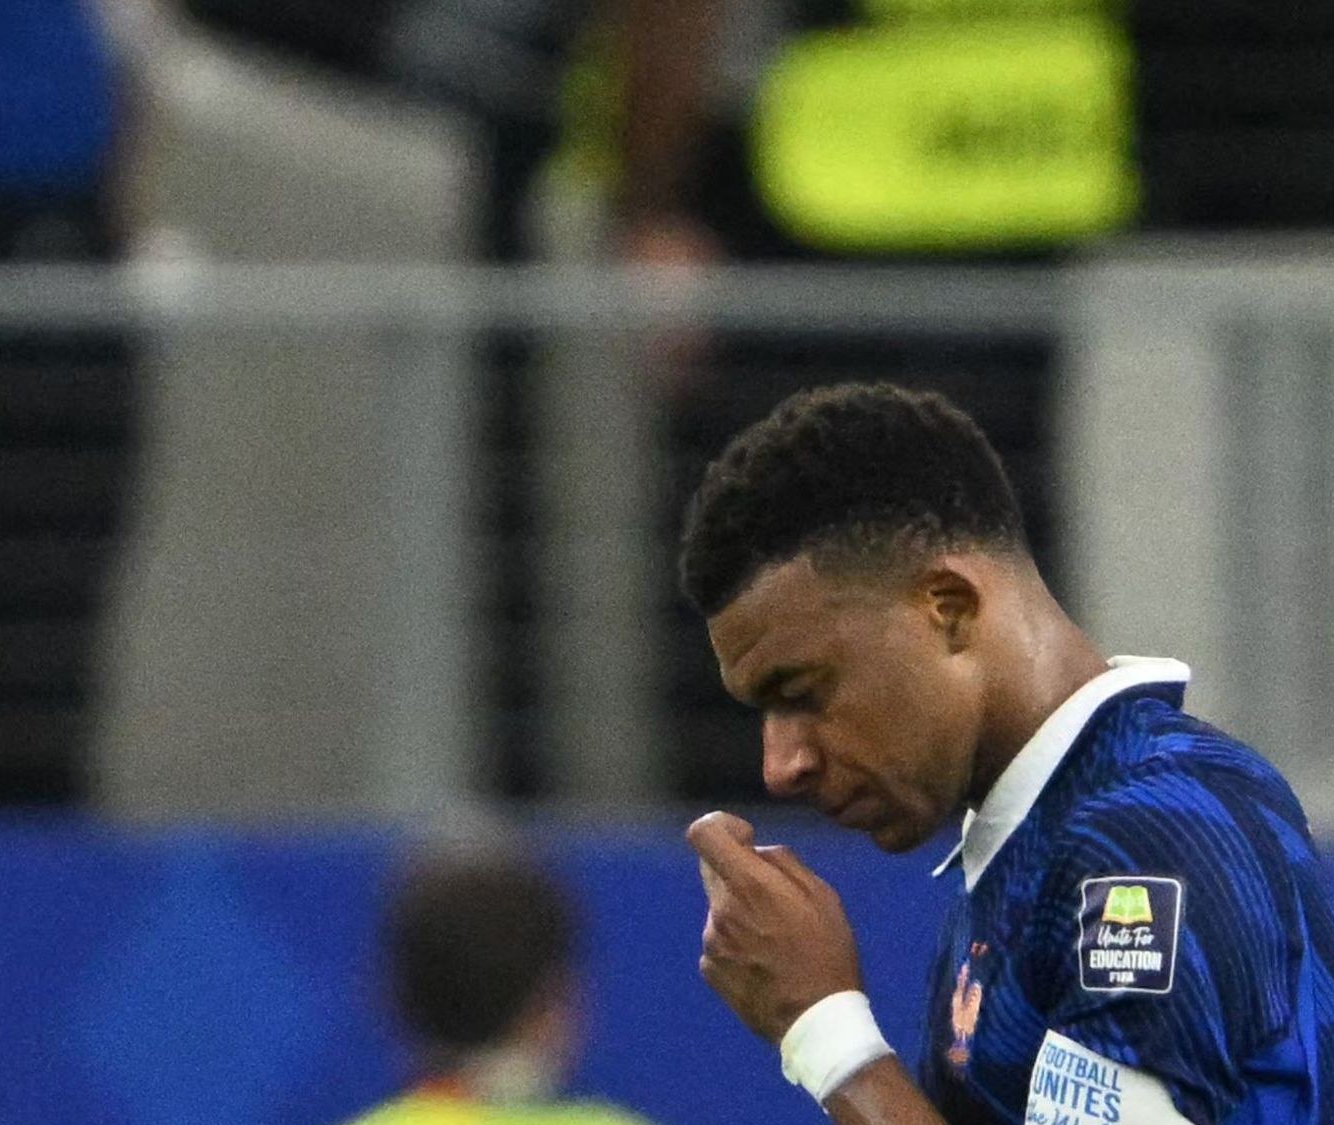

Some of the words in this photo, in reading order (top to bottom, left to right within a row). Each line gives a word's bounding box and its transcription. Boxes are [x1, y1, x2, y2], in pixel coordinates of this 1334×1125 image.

[1089, 949, 1162, 971] EDUCATION
[1033, 1065, 1121, 1123] UNITES
[1028, 1100, 1048, 1125] he
